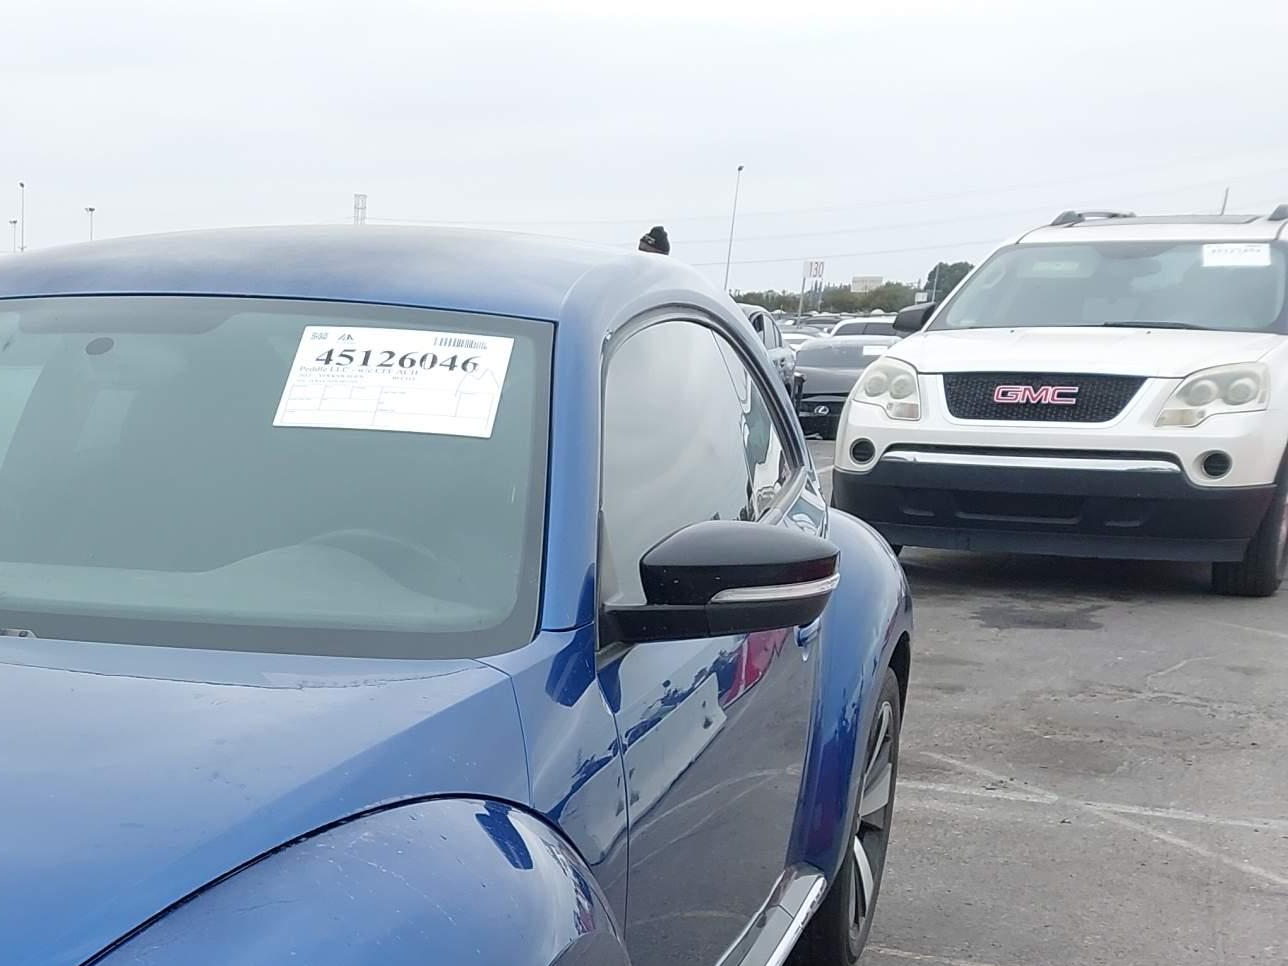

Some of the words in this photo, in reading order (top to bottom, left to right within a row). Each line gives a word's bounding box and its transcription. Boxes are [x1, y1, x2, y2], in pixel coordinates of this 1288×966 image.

[808, 261, 825, 278] 130
[314, 348, 482, 374] 45126046
[993, 385, 1080, 405] GMC
